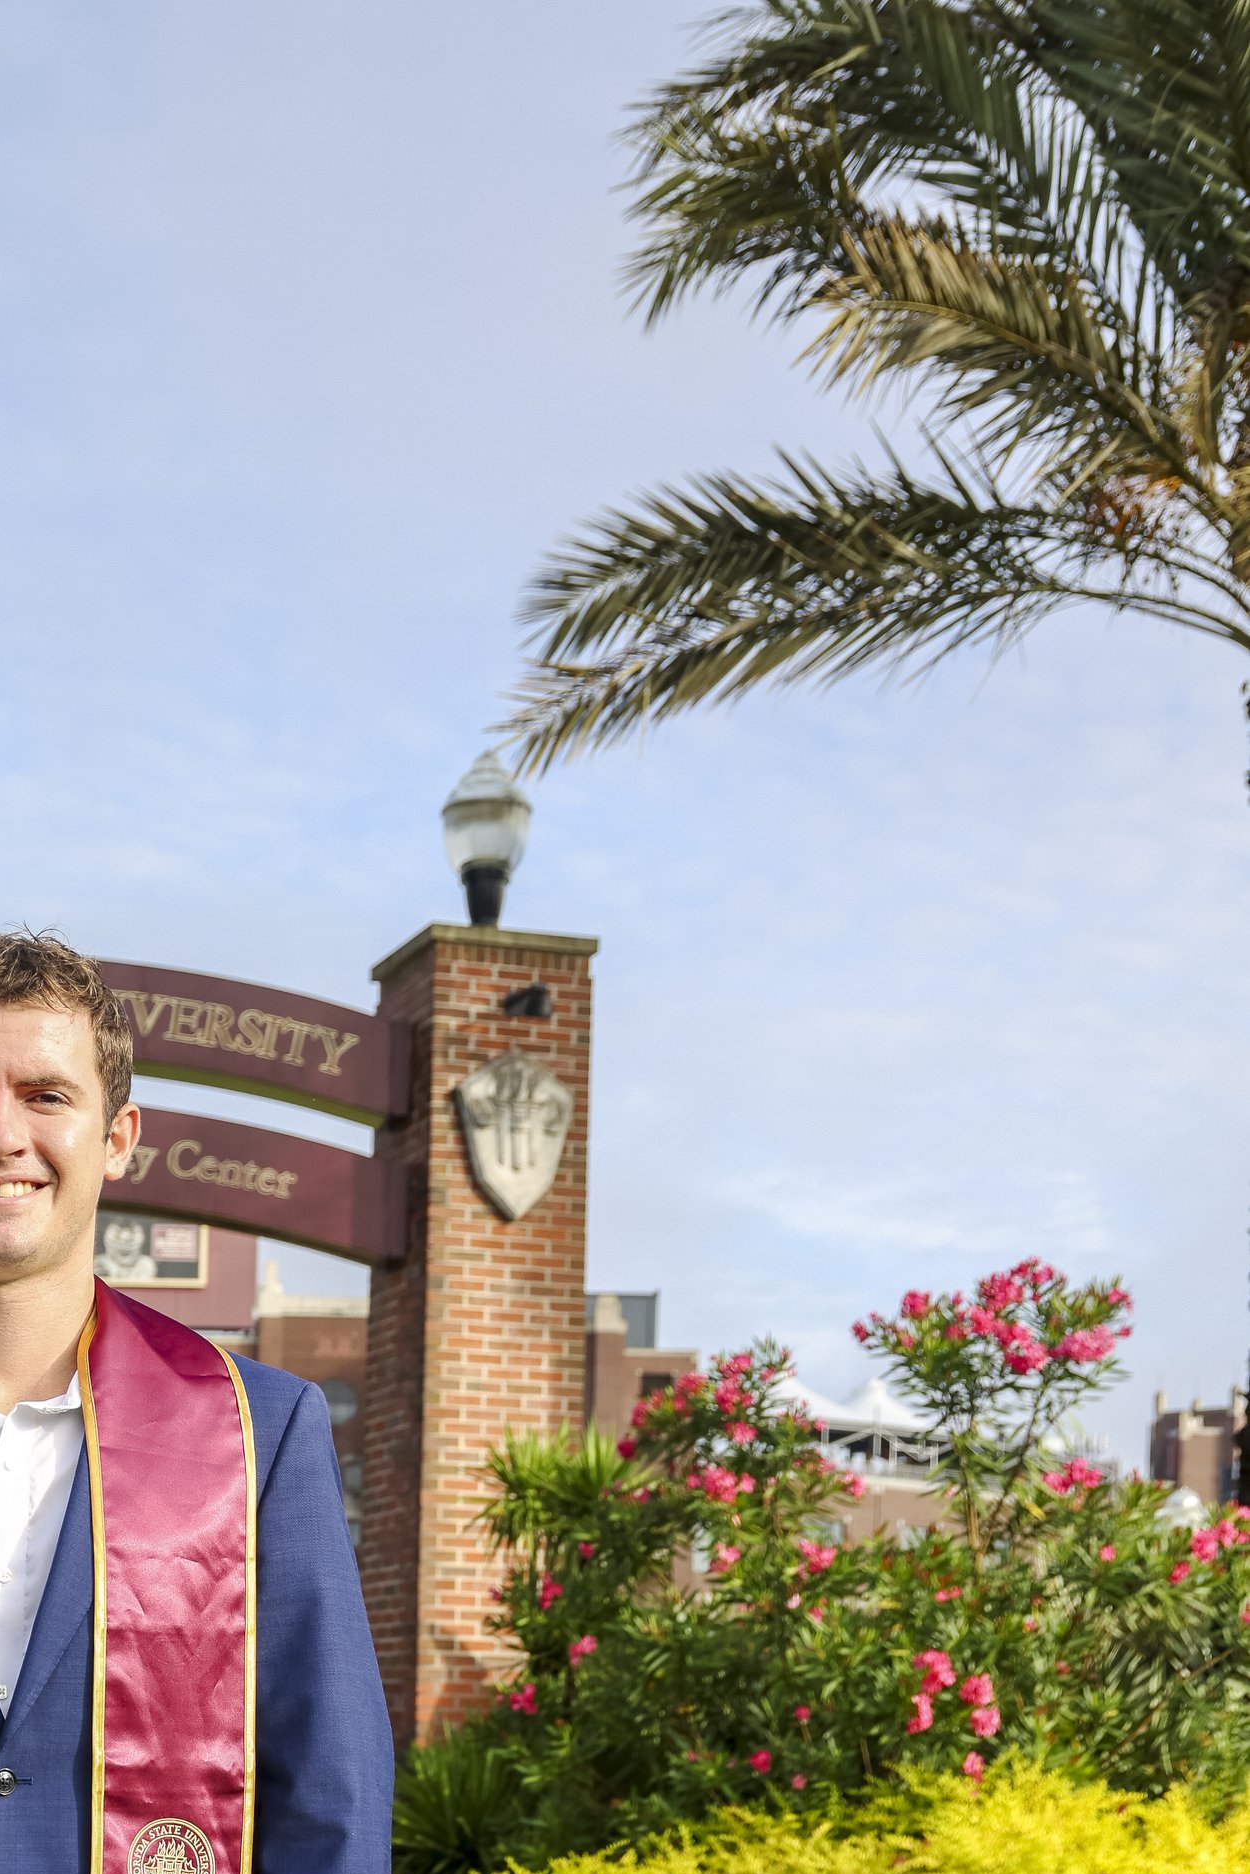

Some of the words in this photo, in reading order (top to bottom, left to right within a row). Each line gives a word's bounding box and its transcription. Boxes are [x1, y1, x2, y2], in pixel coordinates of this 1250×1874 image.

[110, 989, 359, 1076] VERSITY
[166, 1139, 298, 1199] Center
[149, 1824, 182, 1839] STATE
